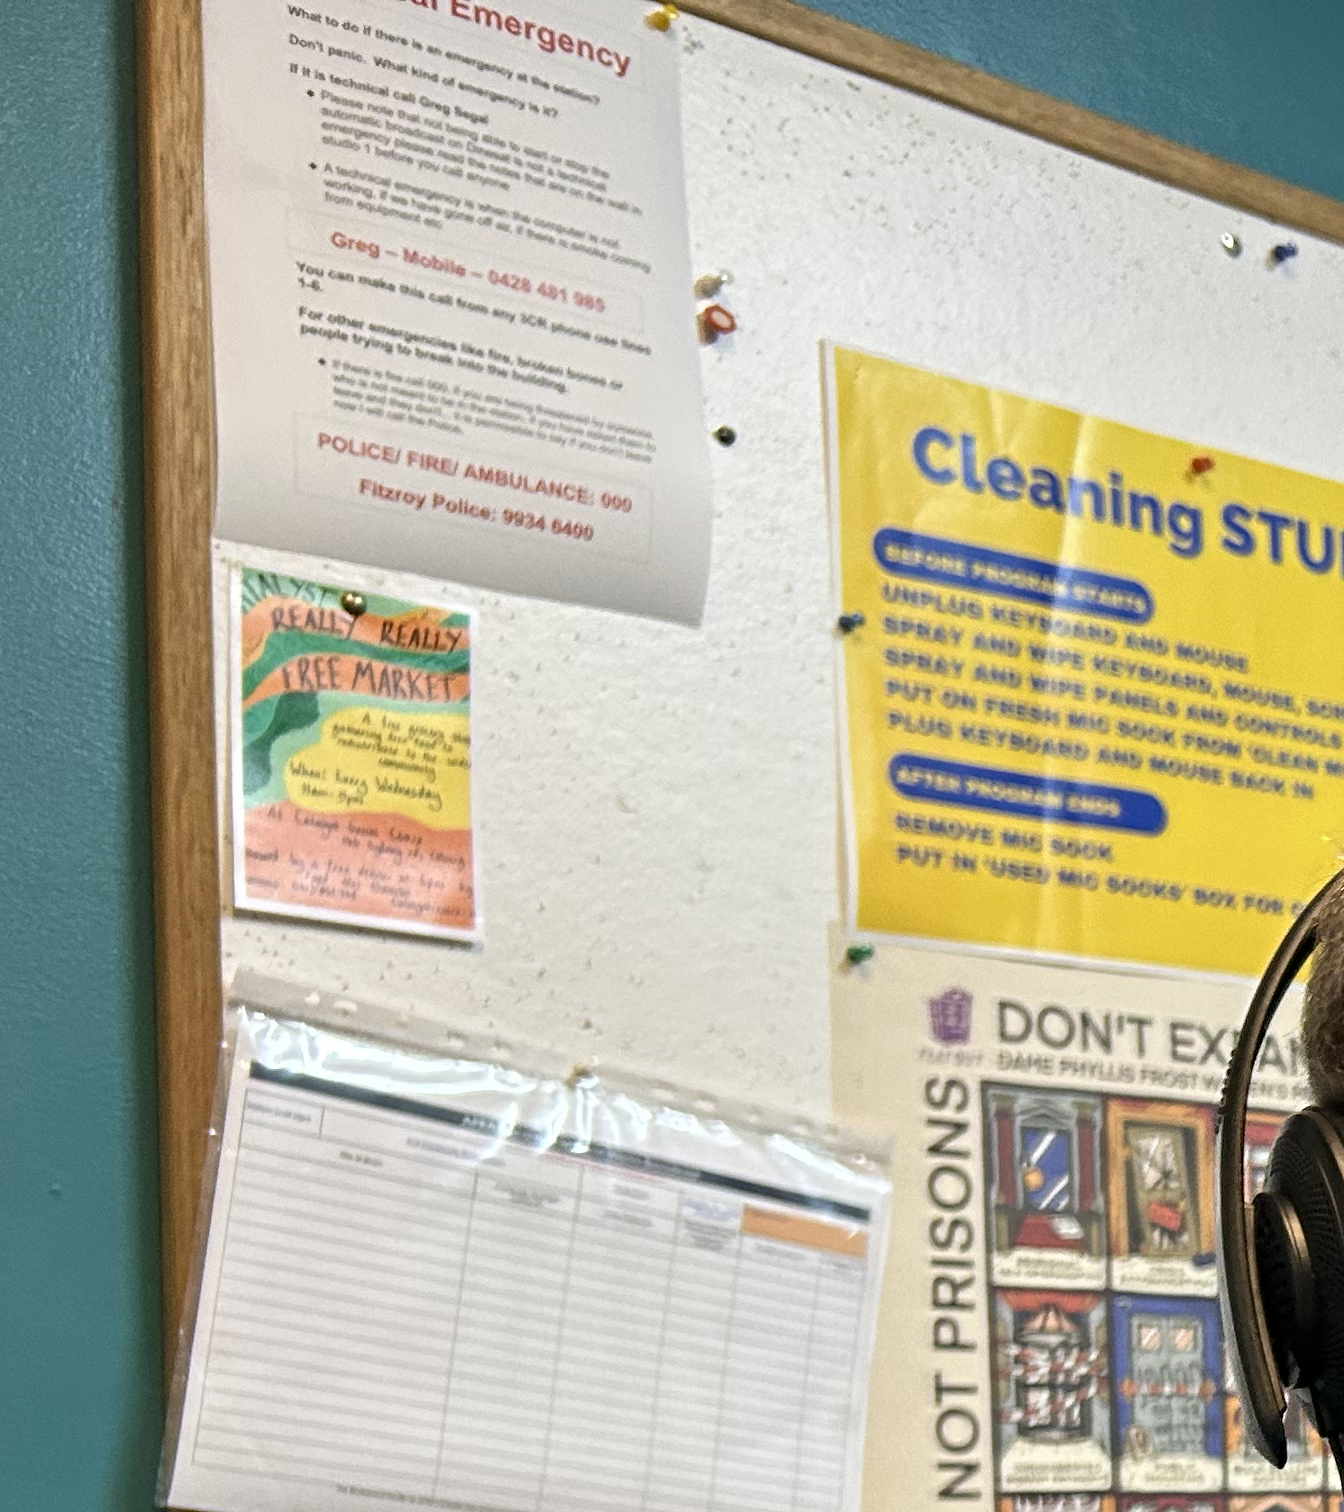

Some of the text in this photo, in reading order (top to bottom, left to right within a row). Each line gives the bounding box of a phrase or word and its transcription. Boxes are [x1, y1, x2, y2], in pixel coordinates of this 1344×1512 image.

[288, 5, 321, 23] What
[326, 15, 339, 27] to
[342, 20, 359, 33] do
[375, 29, 408, 46] there
[450, 0, 631, 78] Emergency
[289, 33, 324, 52] Don't
[373, 55, 408, 73] What
[329, 74, 389, 97] technical
[331, 231, 380, 258] Greg
[403, 247, 466, 277] Mobile
[317, 432, 401, 464] POLICE/
[359, 478, 426, 510] Fitzroy
[911, 426, 1204, 559] Cleaning
[271, 606, 462, 653] REALLY REALLY
[883, 614, 963, 645] SPRAY
[973, 633, 1021, 658] AND
[990, 604, 1118, 646] KEYBOARD
[1125, 630, 1169, 655] AND
[1175, 641, 1249, 673] MOUSE
[282, 655, 456, 701] FREE MARKET
[883, 646, 963, 678] SPRAY
[972, 664, 1022, 689] AND
[1185, 701, 1228, 727] AND
[886, 679, 932, 704] PUT
[984, 697, 1060, 726] FRESH
[960, 725, 1089, 761] KEYBOARD
[1150, 755, 1224, 786] MOUSE
[895, 813, 994, 846] REMOVE
[1001, 829, 1043, 853] MIC
[896, 845, 944, 868] PUT
[998, 999, 1154, 1059] DON'T
[926, 1077, 976, 1349] PRISONS
[933, 1372, 982, 1506] NOT
